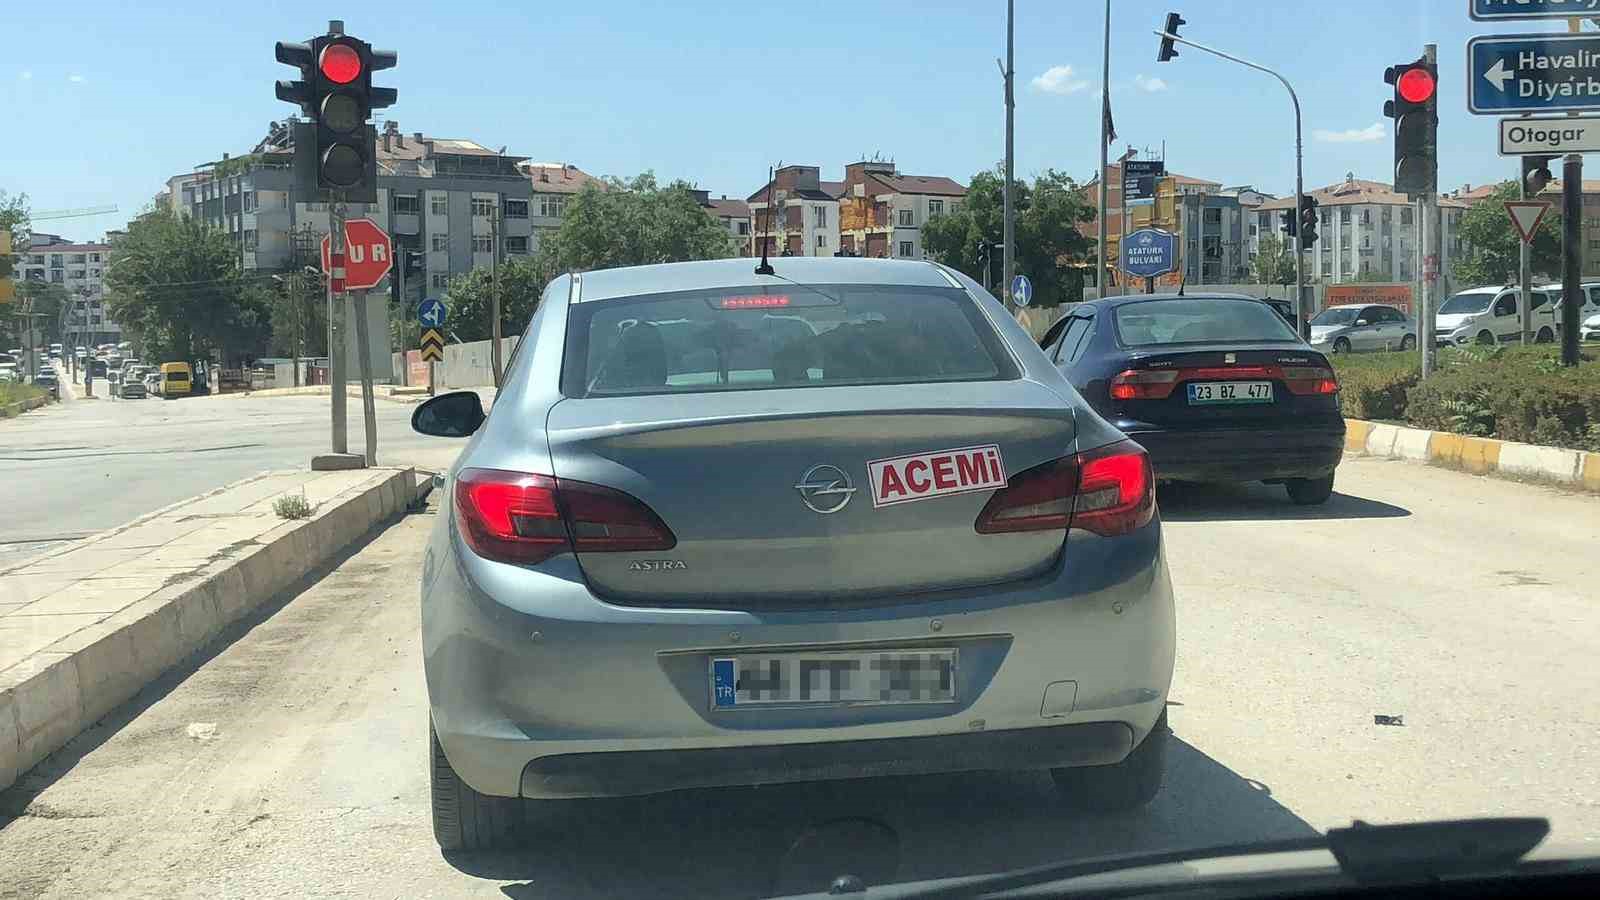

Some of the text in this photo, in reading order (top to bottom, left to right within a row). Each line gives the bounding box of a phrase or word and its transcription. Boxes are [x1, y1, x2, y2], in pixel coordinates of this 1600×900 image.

[1508, 126, 1585, 146] Otogar
[350, 243, 387, 264] UR
[1196, 384, 1269, 400] 23 BZ 477
[629, 560, 687, 570] ASTRA
[716, 686, 732, 698] TR
